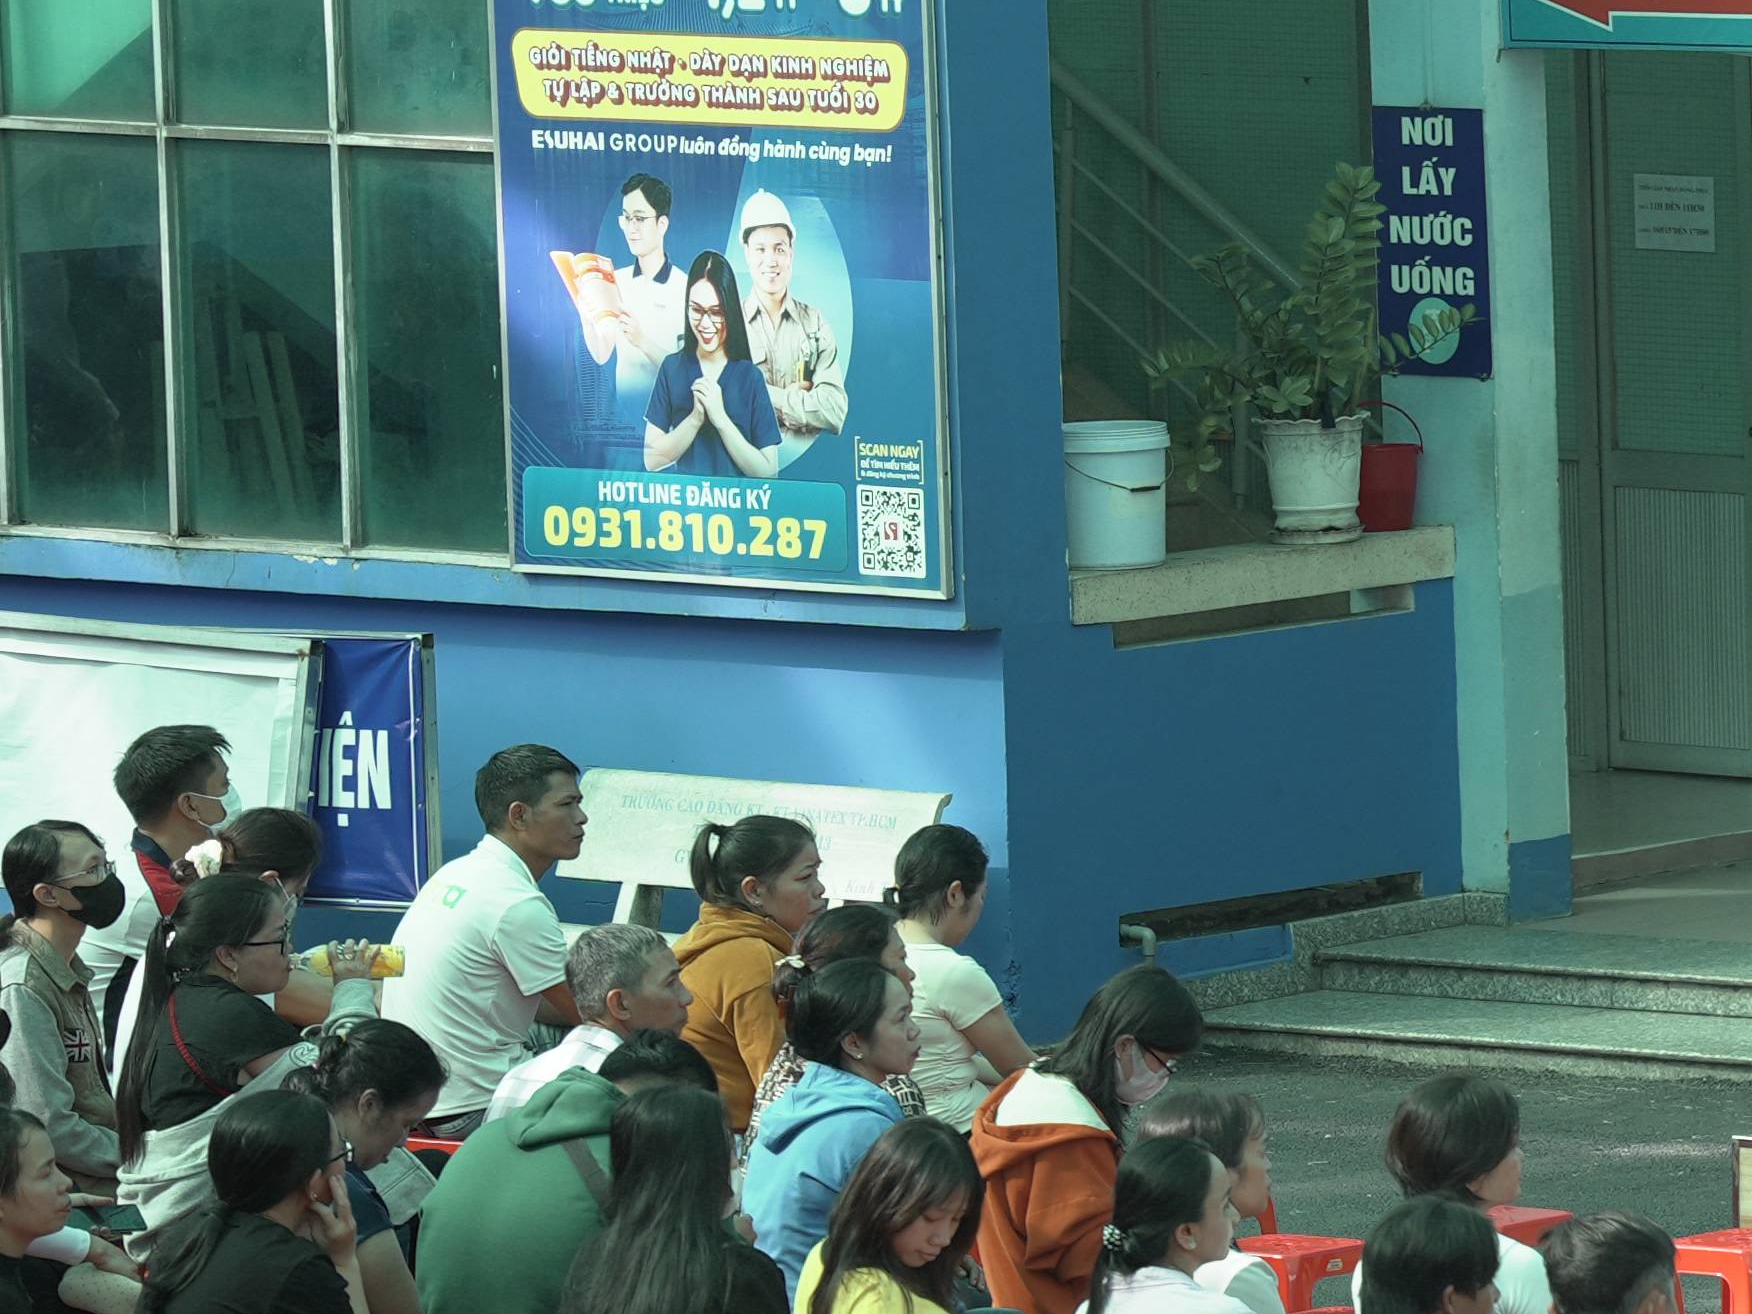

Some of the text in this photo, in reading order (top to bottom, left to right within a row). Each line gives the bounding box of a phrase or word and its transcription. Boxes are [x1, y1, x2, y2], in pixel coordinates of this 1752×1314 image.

[531, 130, 892, 167] ESUHAI GROUP luôn đồng hành cùng bạn!
[1401, 115, 1454, 146] NƠI
[1402, 157, 1456, 195] LẤY
[1389, 211, 1473, 247] NƯỚC
[1391, 256, 1475, 296] UỐNG
[859, 443, 919, 458] SCAN NGAY
[599, 481, 771, 510] HOTLINE ĐĂNG KÝ
[544, 506, 828, 560] 0931.810.287
